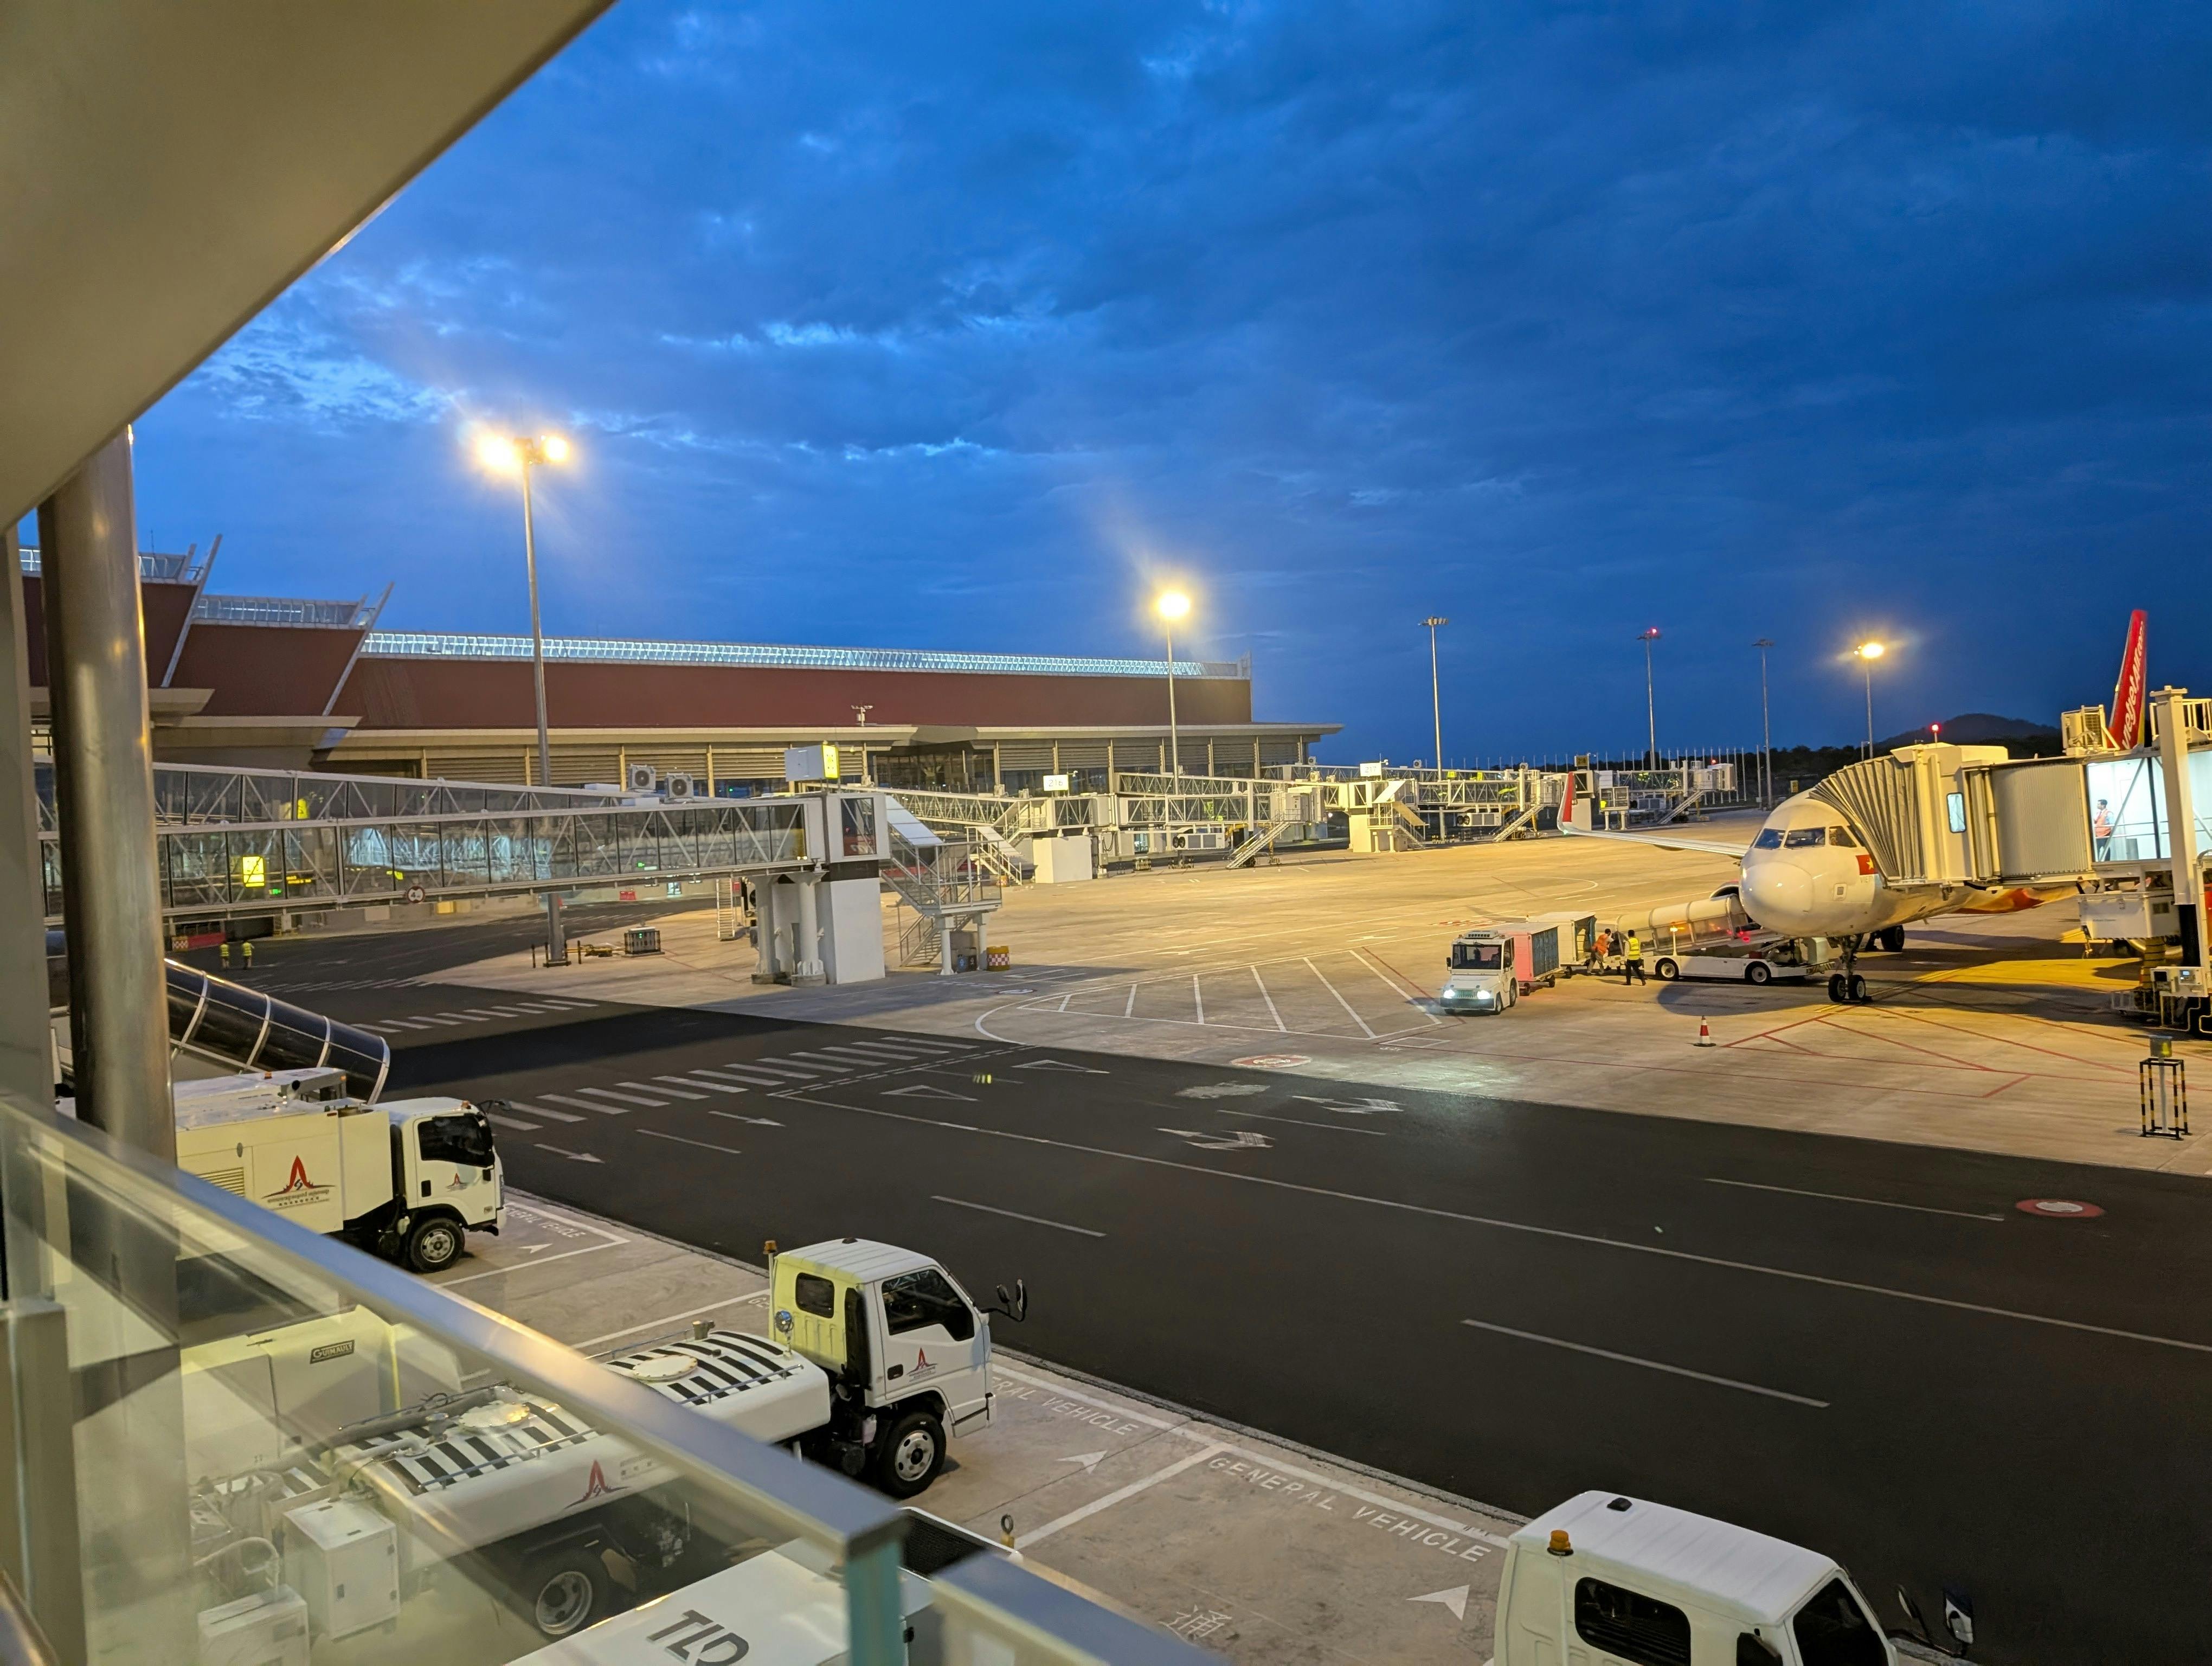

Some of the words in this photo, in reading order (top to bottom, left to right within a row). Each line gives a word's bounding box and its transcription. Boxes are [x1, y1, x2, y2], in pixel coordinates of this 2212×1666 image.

[1041, 1396, 1139, 1436] VEHICLE
[1207, 1457, 1338, 1510] GENERAL
[1352, 1505, 1492, 1562] VEHICLE
[646, 1609, 750, 1666] TLD
